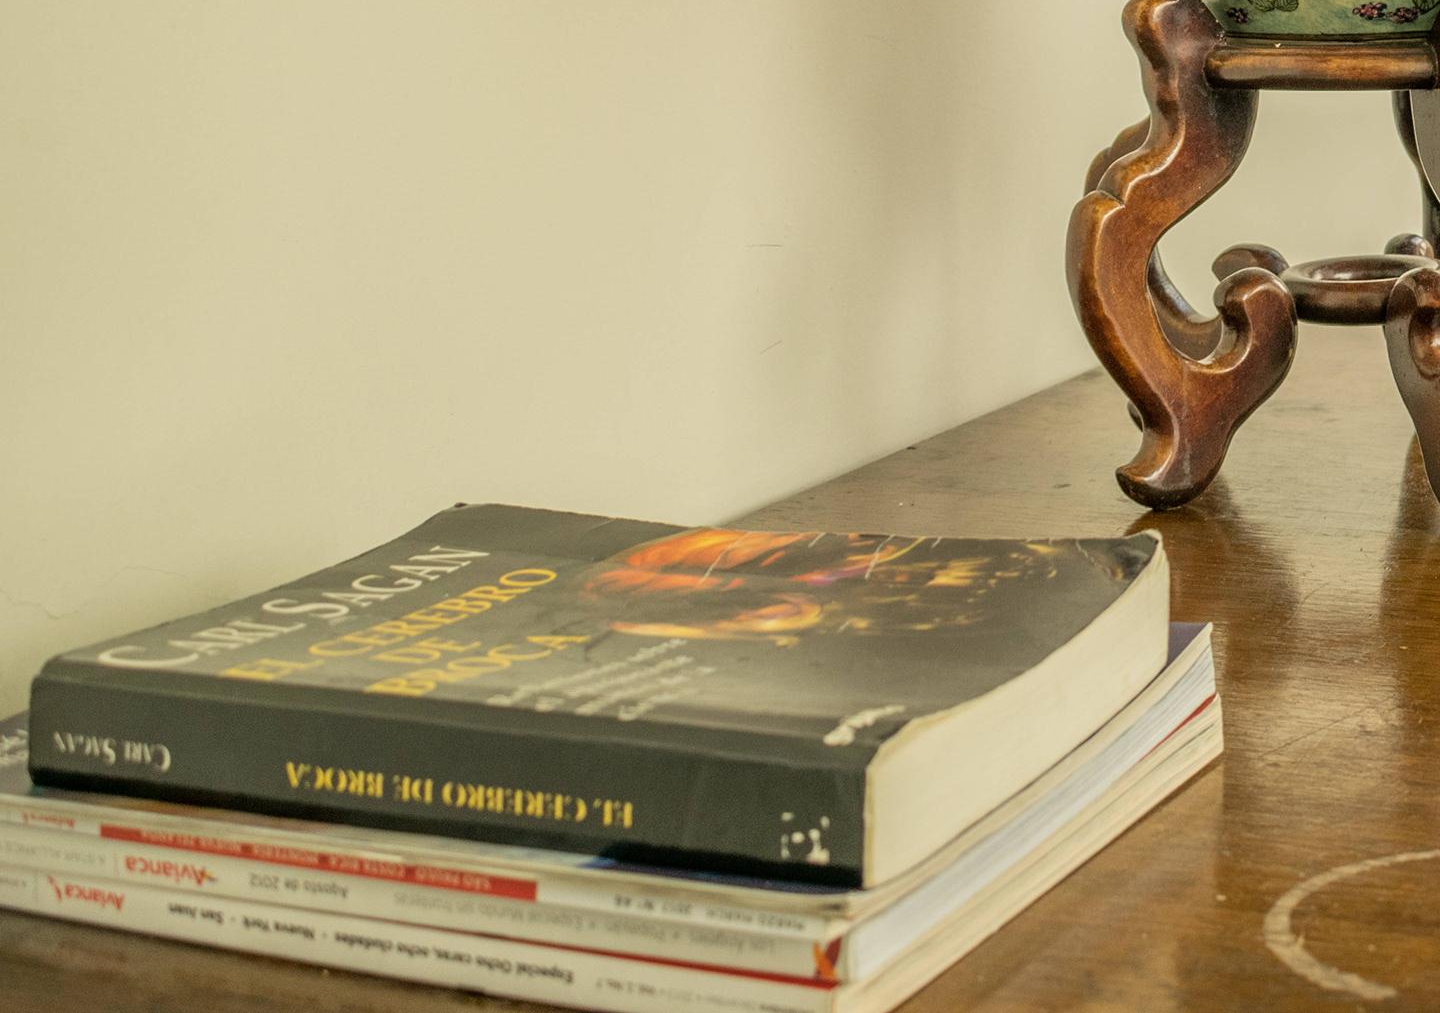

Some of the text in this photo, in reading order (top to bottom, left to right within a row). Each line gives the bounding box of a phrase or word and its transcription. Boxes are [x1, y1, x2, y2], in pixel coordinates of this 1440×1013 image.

[97, 545, 490, 669] CARL SAGAN
[220, 568, 557, 681] EL CEREBRO
[363, 635, 591, 697] BROCA
[369, 636, 481, 664] DE
[53, 731, 117, 765] SAGAN
[123, 739, 172, 773] CARL
[285, 761, 634, 829] EL CEREBRO DE BROCA
[124, 855, 207, 887] Avianca
[63, 881, 125, 912] Avianca
[168, 902, 224, 925] San Juan
